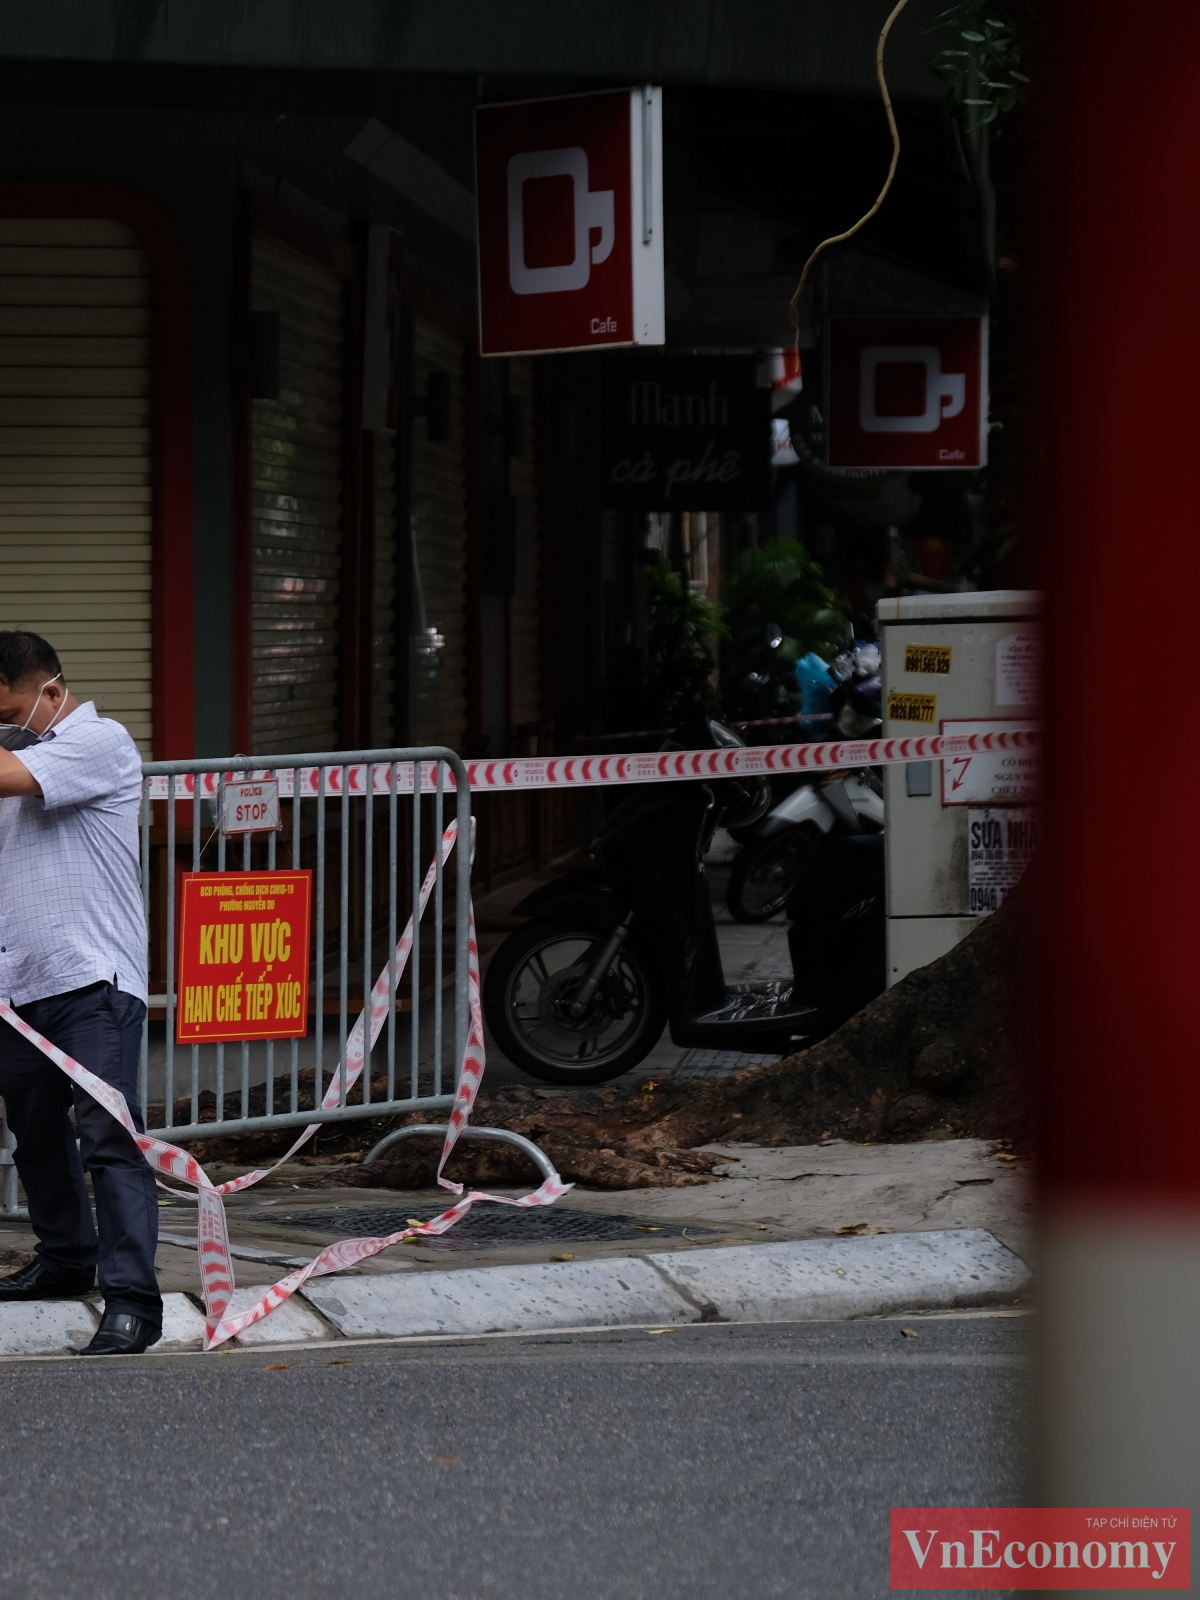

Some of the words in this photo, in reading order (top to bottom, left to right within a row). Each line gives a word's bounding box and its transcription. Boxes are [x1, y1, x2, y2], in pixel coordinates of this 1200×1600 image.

[589, 317, 618, 335] Cafe
[938, 448, 966, 461] Cafe
[612, 449, 658, 483] cà
[664, 438, 741, 499] phê
[1001, 756, 1016, 767] CÓ
[993, 773, 1020, 781] NGUY
[240, 787, 263, 798] POLICE
[236, 804, 268, 822] STOP
[971, 809, 1003, 849] SỬA
[235, 881, 255, 896] CHỐNG
[269, 883, 294, 896] COVID-19
[267, 899, 275, 910] DU
[970, 887, 997, 911] 0946
[199, 923, 244, 965] KHU
[250, 918, 292, 972] VỰC
[184, 985, 213, 1032] HẠN
[216, 971, 244, 1023] CHẾ
[245, 970, 273, 1021] TIẾP
[275, 974, 301, 1020] XÚC
